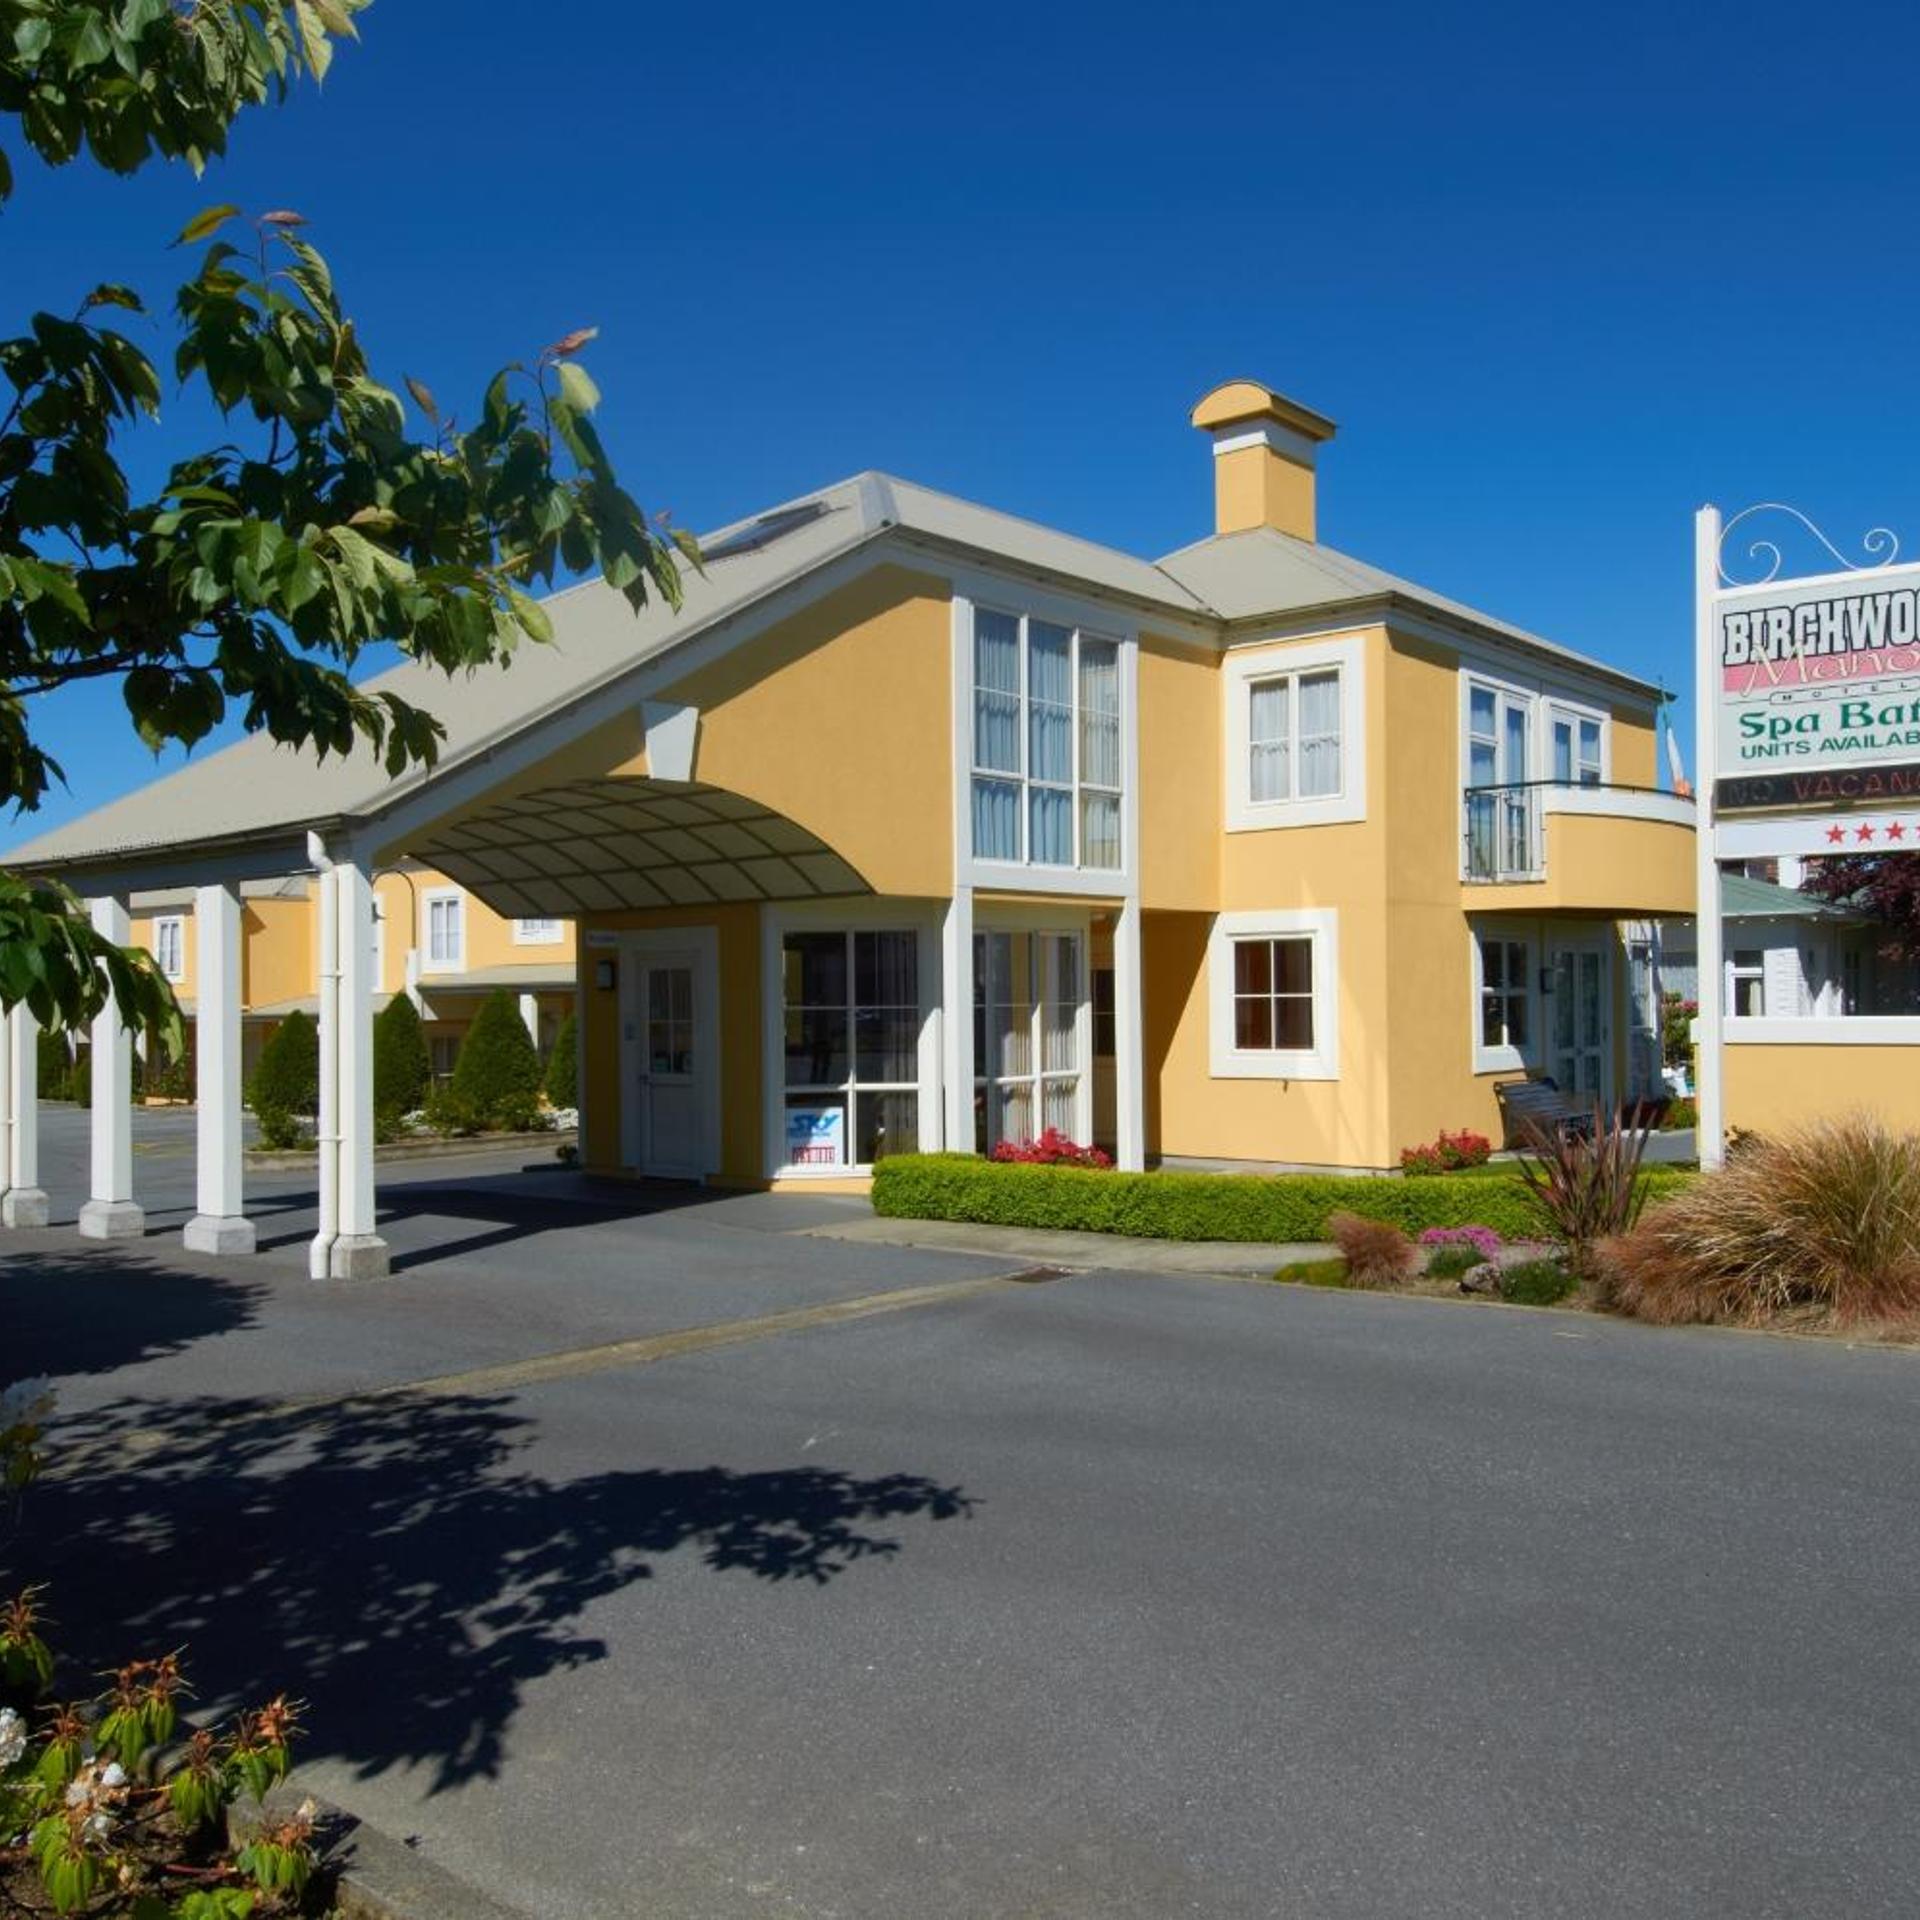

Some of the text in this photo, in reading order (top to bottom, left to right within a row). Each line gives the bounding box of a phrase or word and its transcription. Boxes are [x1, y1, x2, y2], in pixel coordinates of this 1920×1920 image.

[1723, 588, 1920, 667] BIRCHWO
[1741, 640, 1920, 697] Mano
[1783, 682, 1908, 701] MOTEL
[1740, 711, 1820, 741] Spa
[1741, 731, 1920, 759] UNITS AVAILAB
[1731, 769, 1920, 804] NO VACAN
